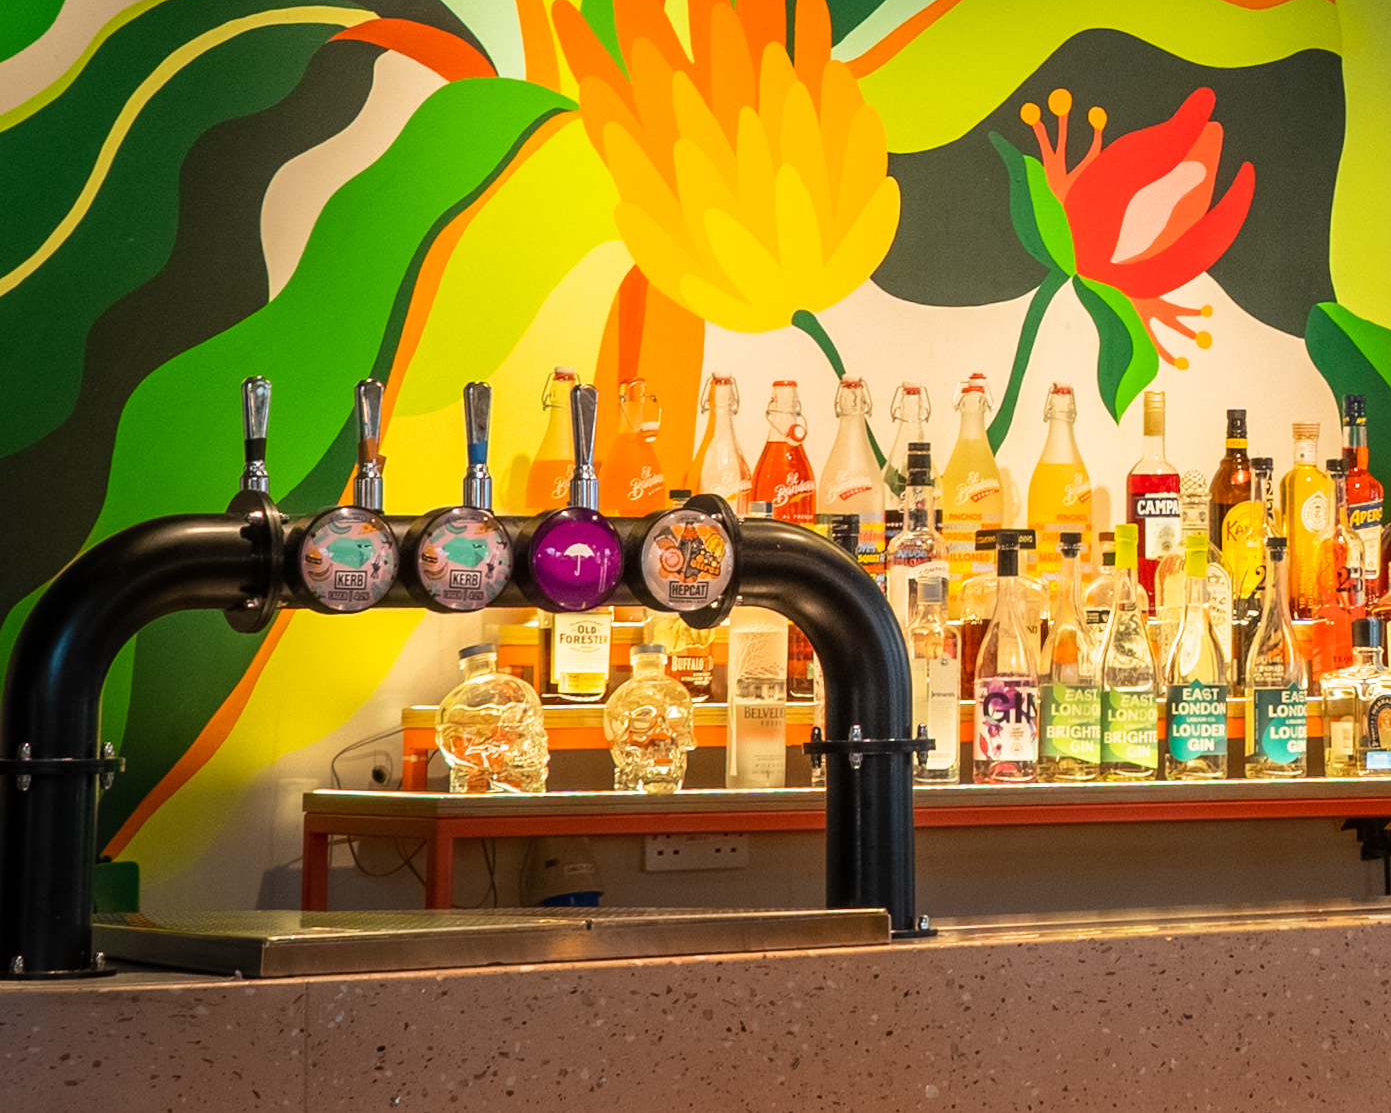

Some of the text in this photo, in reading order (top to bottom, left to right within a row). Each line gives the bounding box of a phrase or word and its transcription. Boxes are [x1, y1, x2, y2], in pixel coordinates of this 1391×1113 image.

[1137, 498, 1180, 515] CAMPA
[1350, 505, 1383, 527] APERO
[337, 573, 363, 587] KERB
[452, 573, 478, 586] KERB
[672, 584, 707, 596] HEPCAT
[577, 624, 597, 635] OLD
[559, 633, 608, 645] FORESTER
[1064, 688, 1098, 702] EAST
[1120, 694, 1155, 707] EAST
[1182, 688, 1219, 701] EAST
[1171, 702, 1226, 715] LONDON
[1172, 724, 1226, 737] LOUDER
[1069, 740, 1094, 754] GIN
[1126, 745, 1151, 758] GIN
[1186, 738, 1215, 752] GIN
